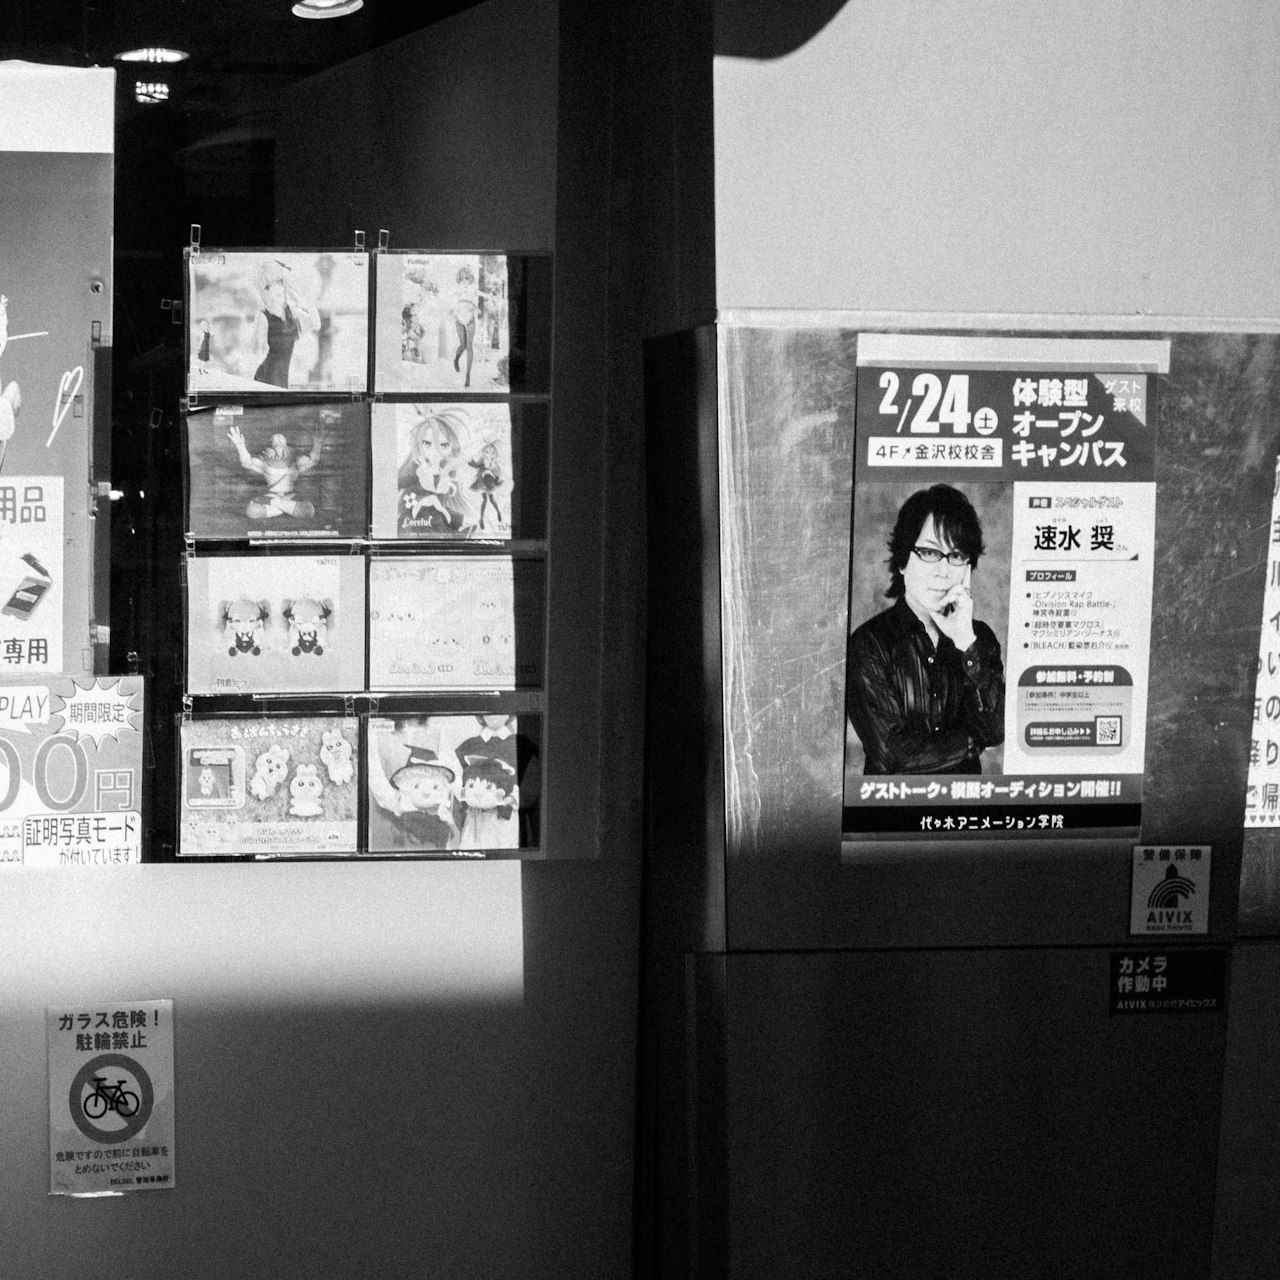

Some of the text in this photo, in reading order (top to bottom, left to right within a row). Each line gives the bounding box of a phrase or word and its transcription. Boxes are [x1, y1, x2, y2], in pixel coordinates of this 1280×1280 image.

[1012, 378, 1088, 407] 体験型
[1105, 379, 1141, 395] ゲスト
[1113, 397, 1142, 413] 来校
[1012, 410, 1105, 437] オープン
[876, 444, 995, 461] 4F 金沢校校舎
[1011, 439, 1127, 467] キャンパス
[1034, 525, 1081, 551] 速水
[1091, 525, 1114, 551] 奨
[1029, 572, 1073, 582] プロフィール
[1070, 601, 1083, 610] Rap
[69, 702, 126, 724] 期間限定
[25, 814, 139, 847] 証明写真モード
[920, 814, 1064, 830] 代々木アニメーション学院
[1147, 911, 1193, 924] AIVIX
[1120, 956, 1168, 974] カメラ
[1117, 975, 1168, 993] 作動中
[1117, 1000, 1147, 1010] AIVIX
[76, 1030, 148, 1051] 駐輪禁止
[56, 1146, 169, 1162] 危険ですので前に自転車を
[75, 1161, 151, 1175] とめないでください
